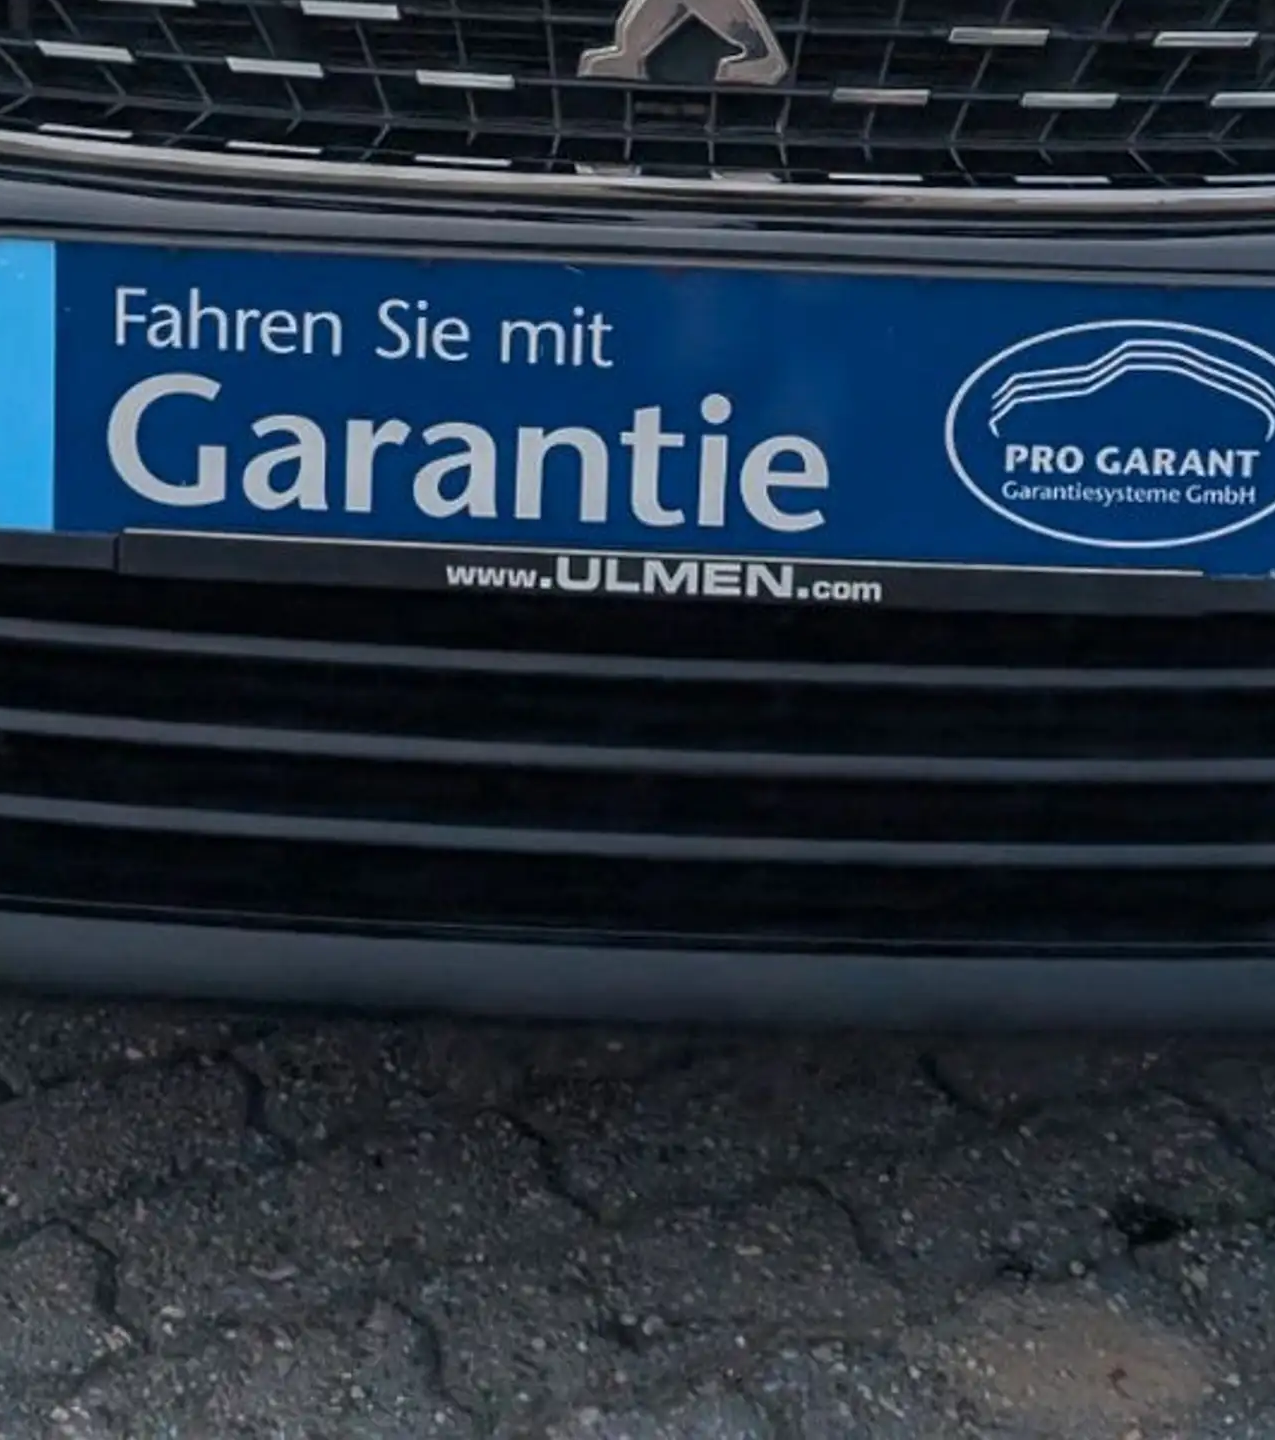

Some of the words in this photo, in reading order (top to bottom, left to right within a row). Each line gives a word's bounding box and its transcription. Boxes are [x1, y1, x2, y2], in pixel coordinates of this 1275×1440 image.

[114, 285, 344, 357] Fahren
[374, 297, 471, 362] Sie
[499, 305, 615, 369] mit
[106, 372, 831, 534] Garantie
[1004, 443, 1084, 475] PRO
[1095, 446, 1261, 479] GARANT
[1000, 479, 1181, 508] Garantiesysteme
[1185, 483, 1257, 506] GmbH
[445, 555, 884, 603] www.ULMEN.com
